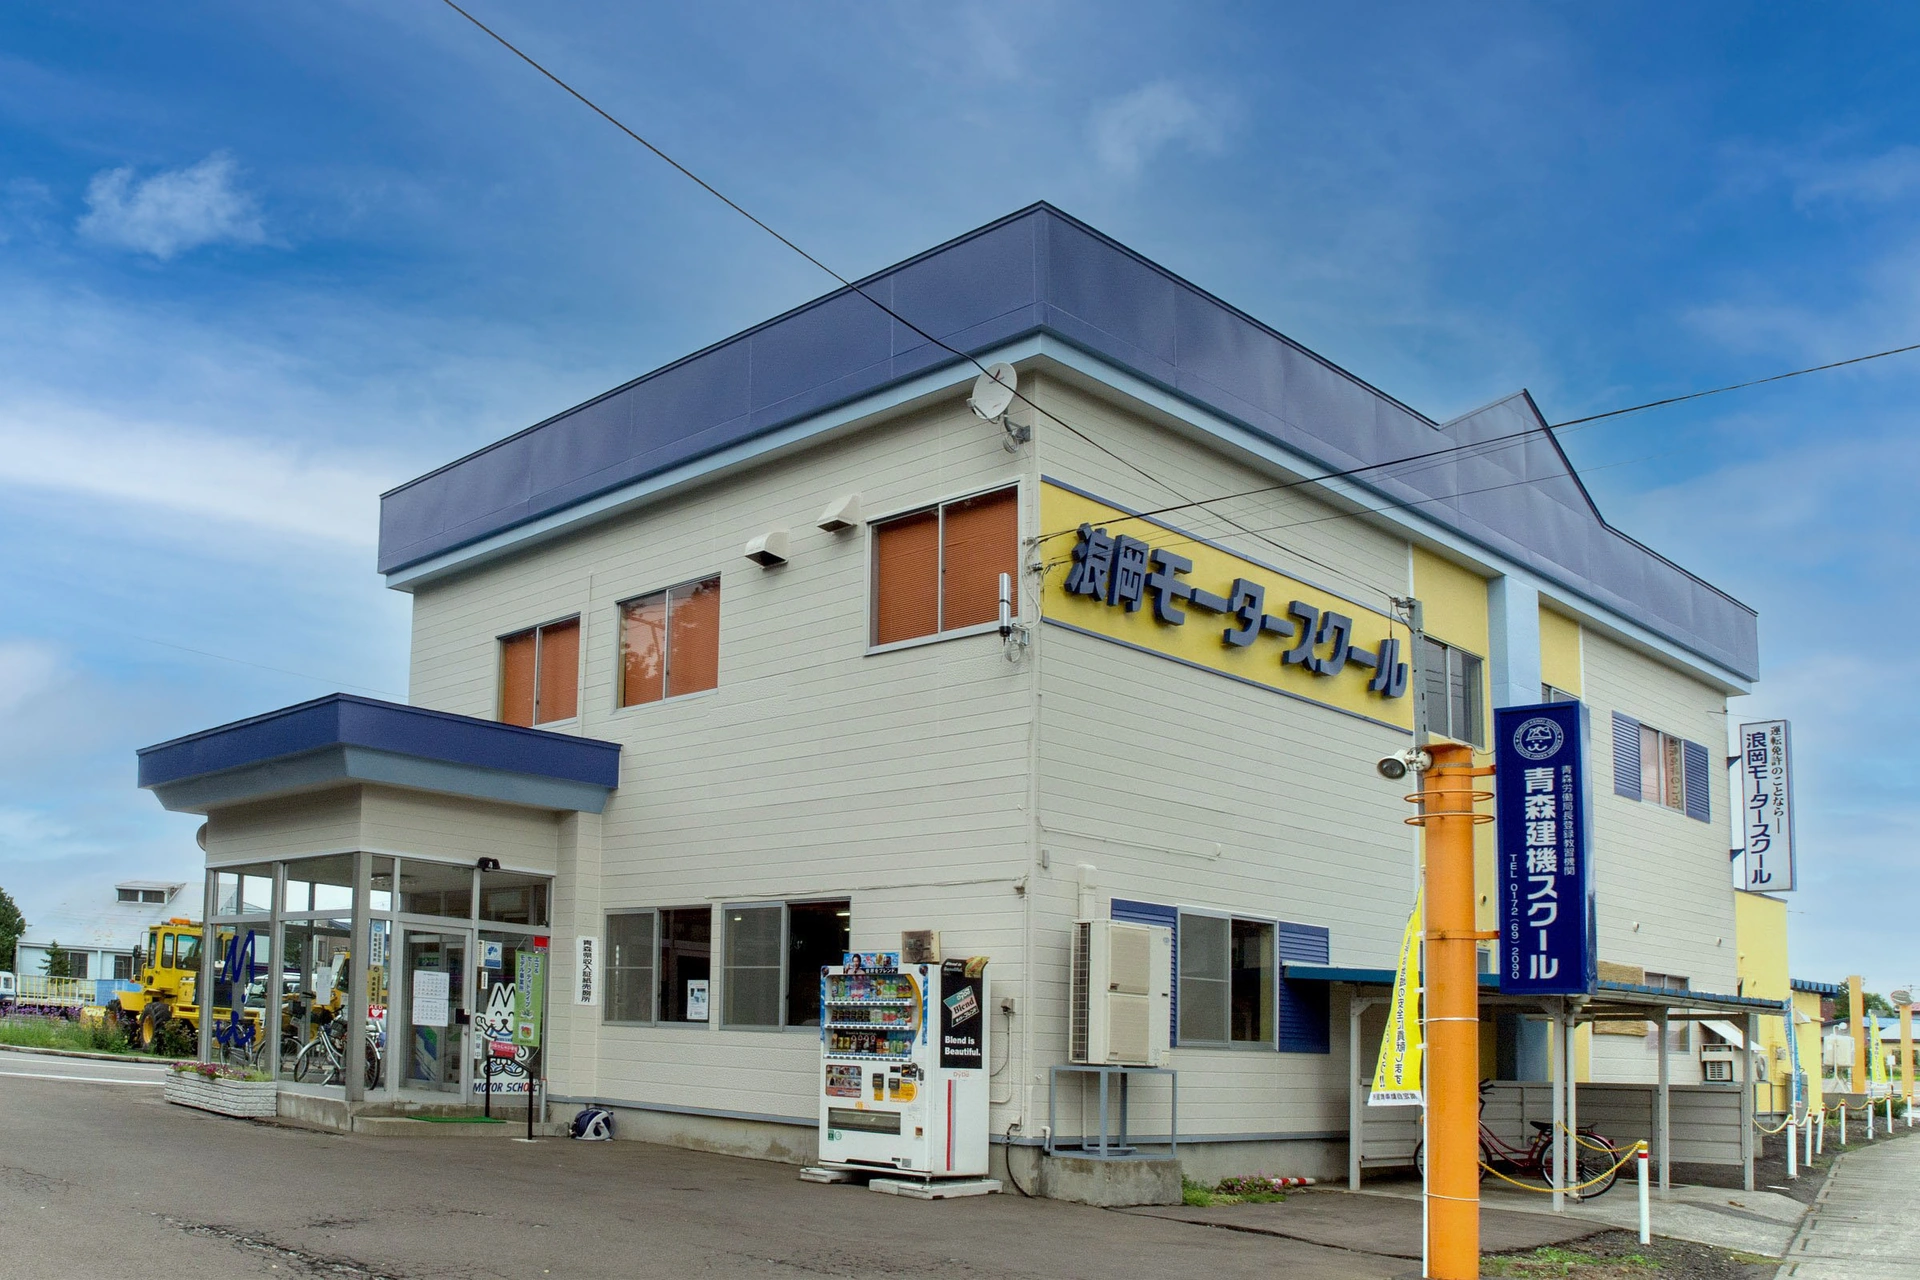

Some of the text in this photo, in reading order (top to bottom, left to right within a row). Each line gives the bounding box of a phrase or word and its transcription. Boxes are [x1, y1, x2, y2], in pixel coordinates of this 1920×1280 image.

[1063, 522, 1408, 698] 浪岡モータースクール
[1561, 765, 1575, 875] 青森労働局長登録教習機関
[1746, 731, 1772, 884] 浪岡モータースクール
[1524, 767, 1558, 979] 青森建機スクール
[953, 997, 975, 1014] Blend
[944, 1035, 975, 1045] Blend is
[944, 1046, 981, 1056] Beautiful.
[473, 1082, 538, 1093] MOOR SCHOL
